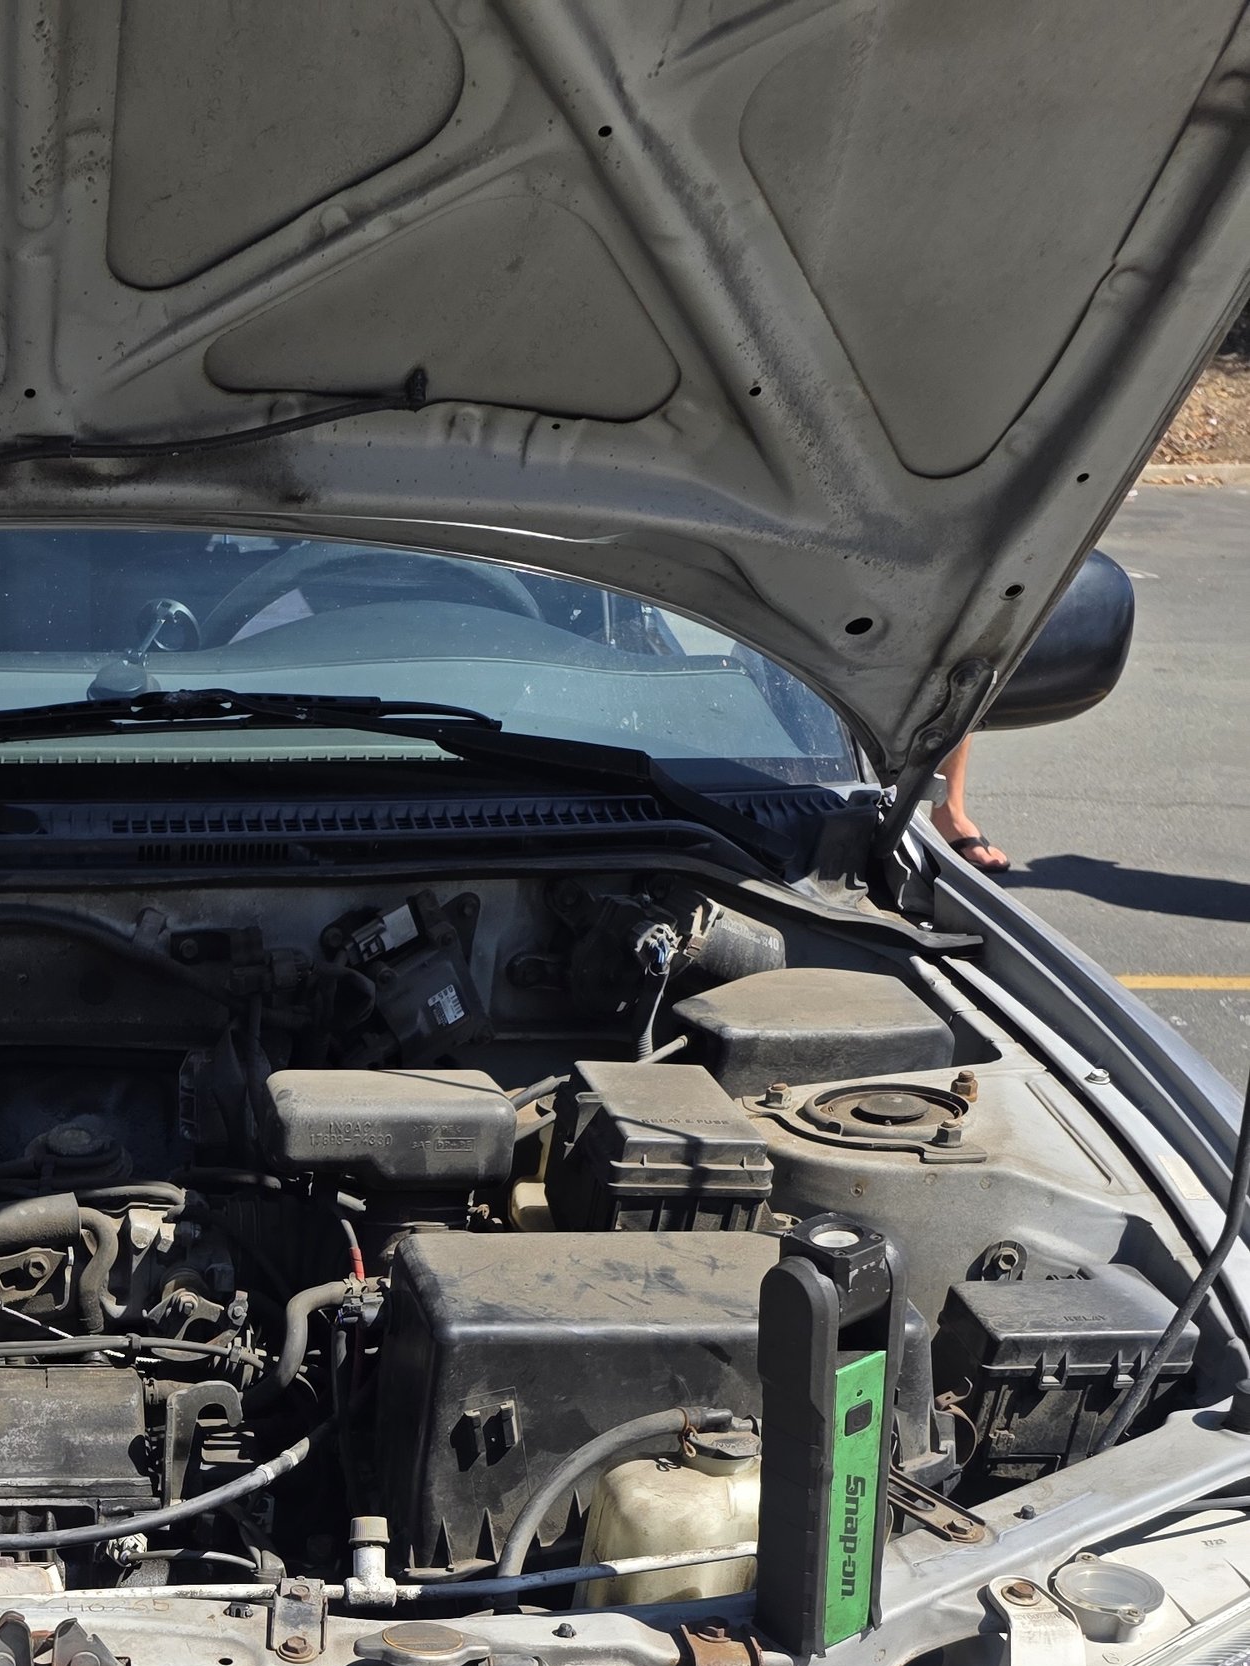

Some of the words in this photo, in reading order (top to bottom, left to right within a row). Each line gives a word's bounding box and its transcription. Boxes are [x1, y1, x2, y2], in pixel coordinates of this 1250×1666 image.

[329, 1121, 371, 1133] INOAC
[1063, 1314, 1107, 1322] RELAY
[840, 1474, 866, 1598] Snap-on
